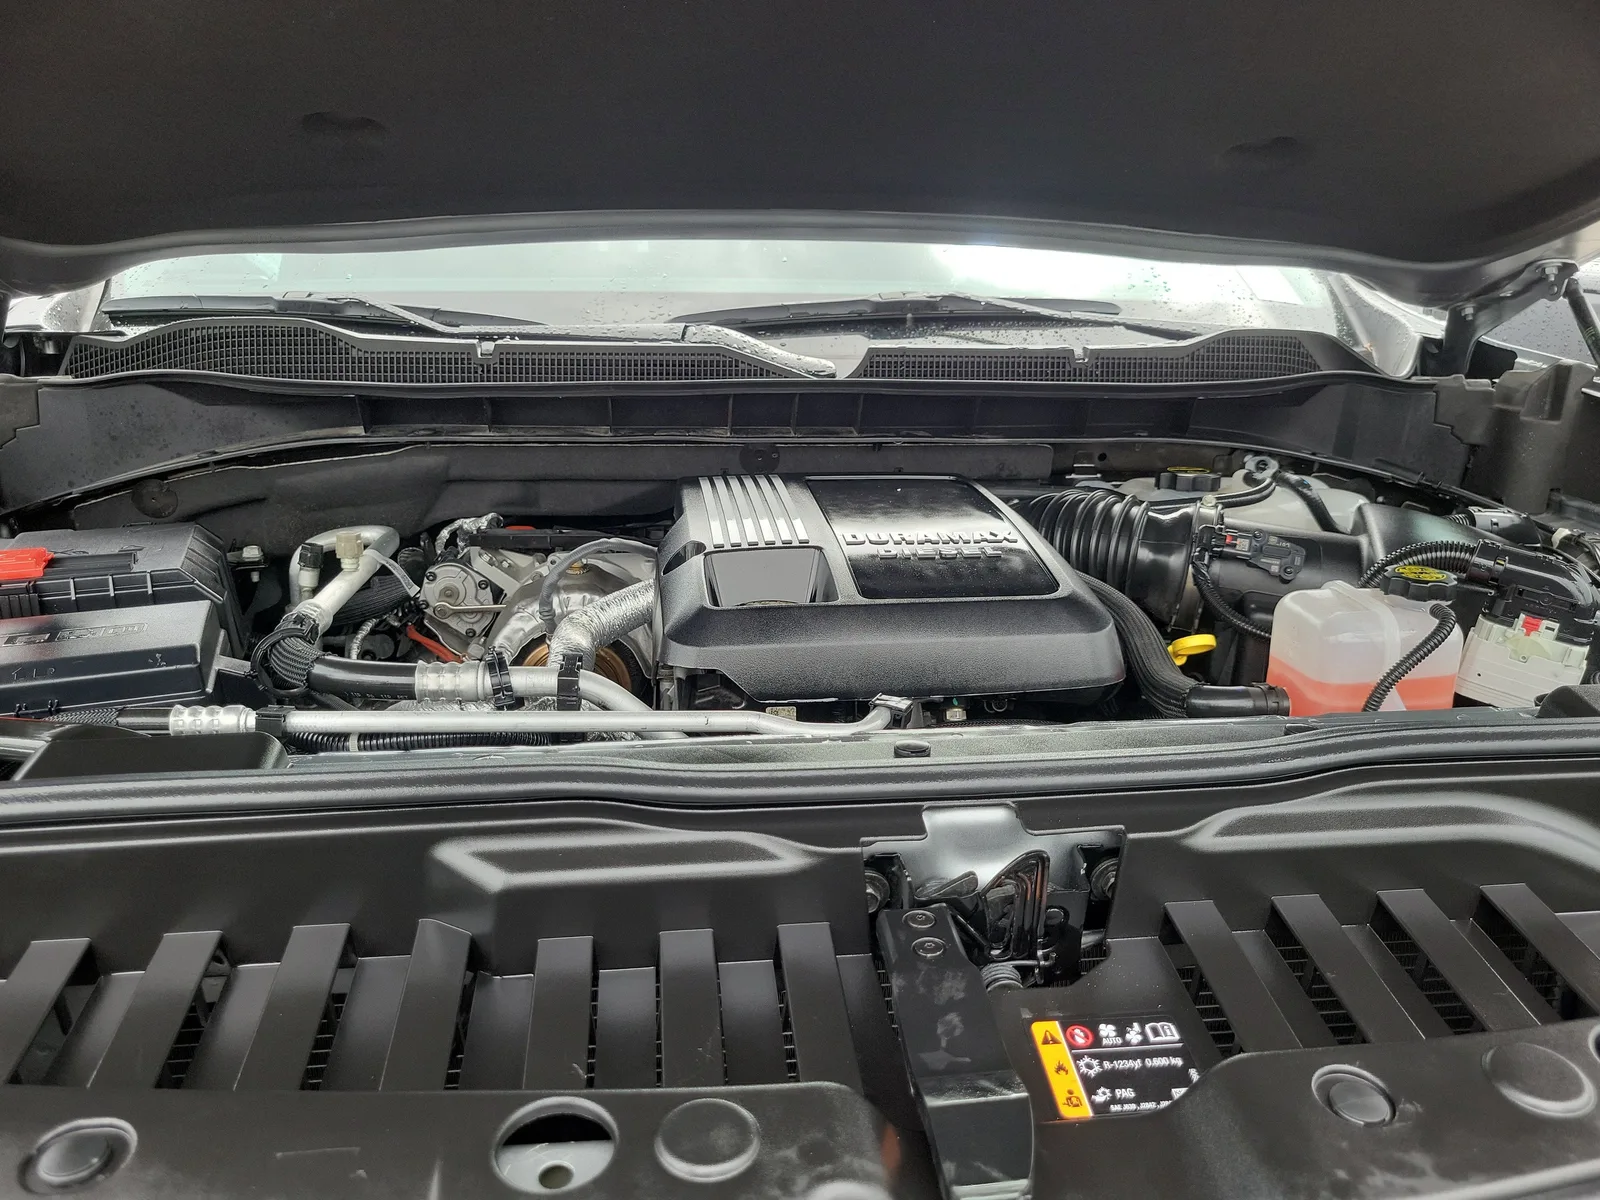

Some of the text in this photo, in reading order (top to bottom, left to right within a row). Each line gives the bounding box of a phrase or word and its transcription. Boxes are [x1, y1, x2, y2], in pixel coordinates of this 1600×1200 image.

[842, 530, 1018, 546] DURAMAX
[877, 547, 1002, 560] DIESEL
[1102, 1037, 1122, 1046] AUTO
[1170, 1056, 1184, 1067] kg
[1115, 1088, 1136, 1099] PAG
